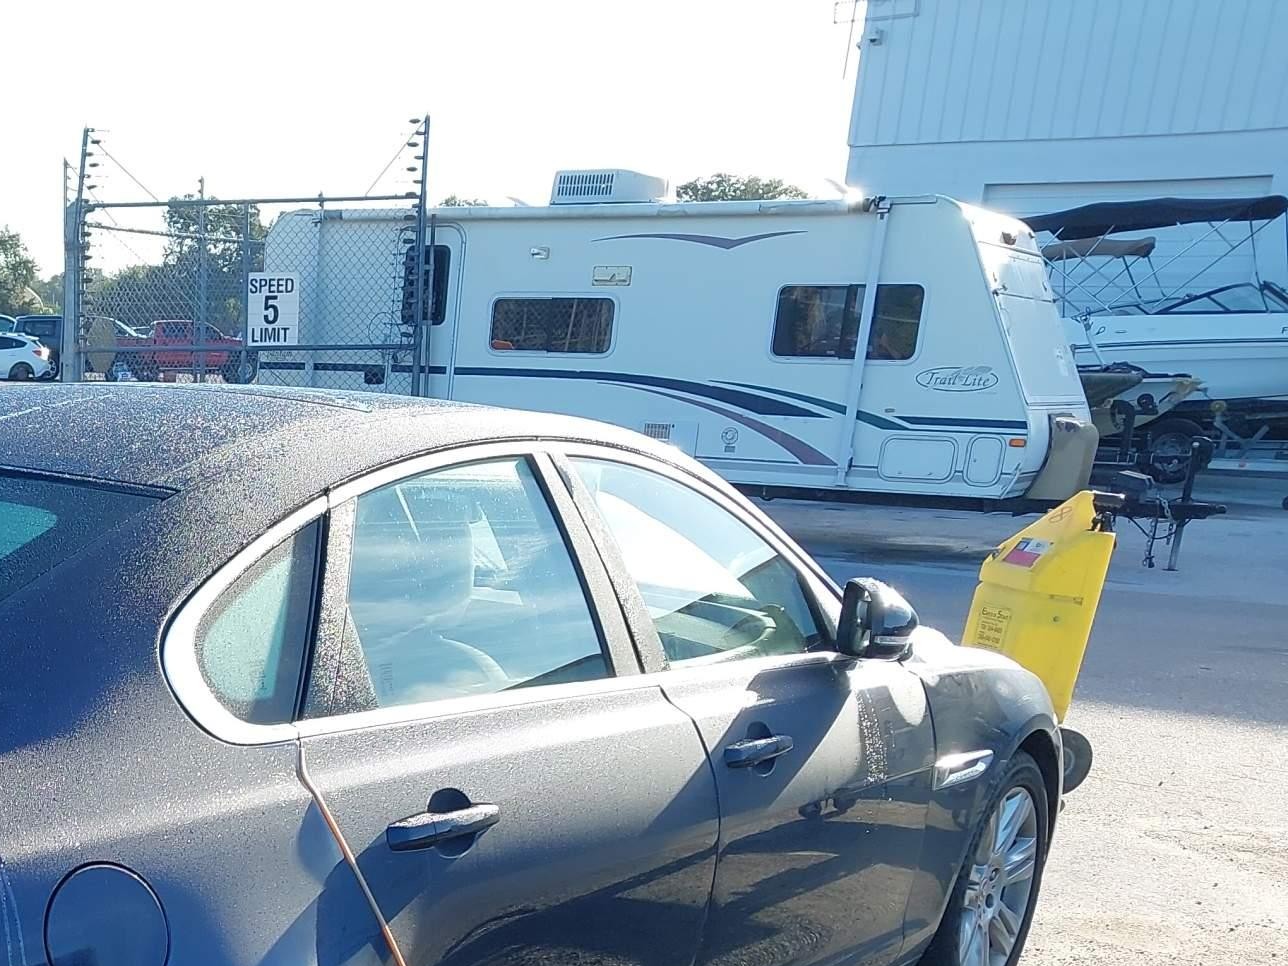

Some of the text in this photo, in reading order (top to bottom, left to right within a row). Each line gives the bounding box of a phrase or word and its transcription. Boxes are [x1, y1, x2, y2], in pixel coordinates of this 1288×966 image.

[249, 278, 294, 294] SPEED
[263, 295, 279, 325] 5
[251, 327, 290, 343] LIMIT
[925, 371, 990, 387] Trail Lite
